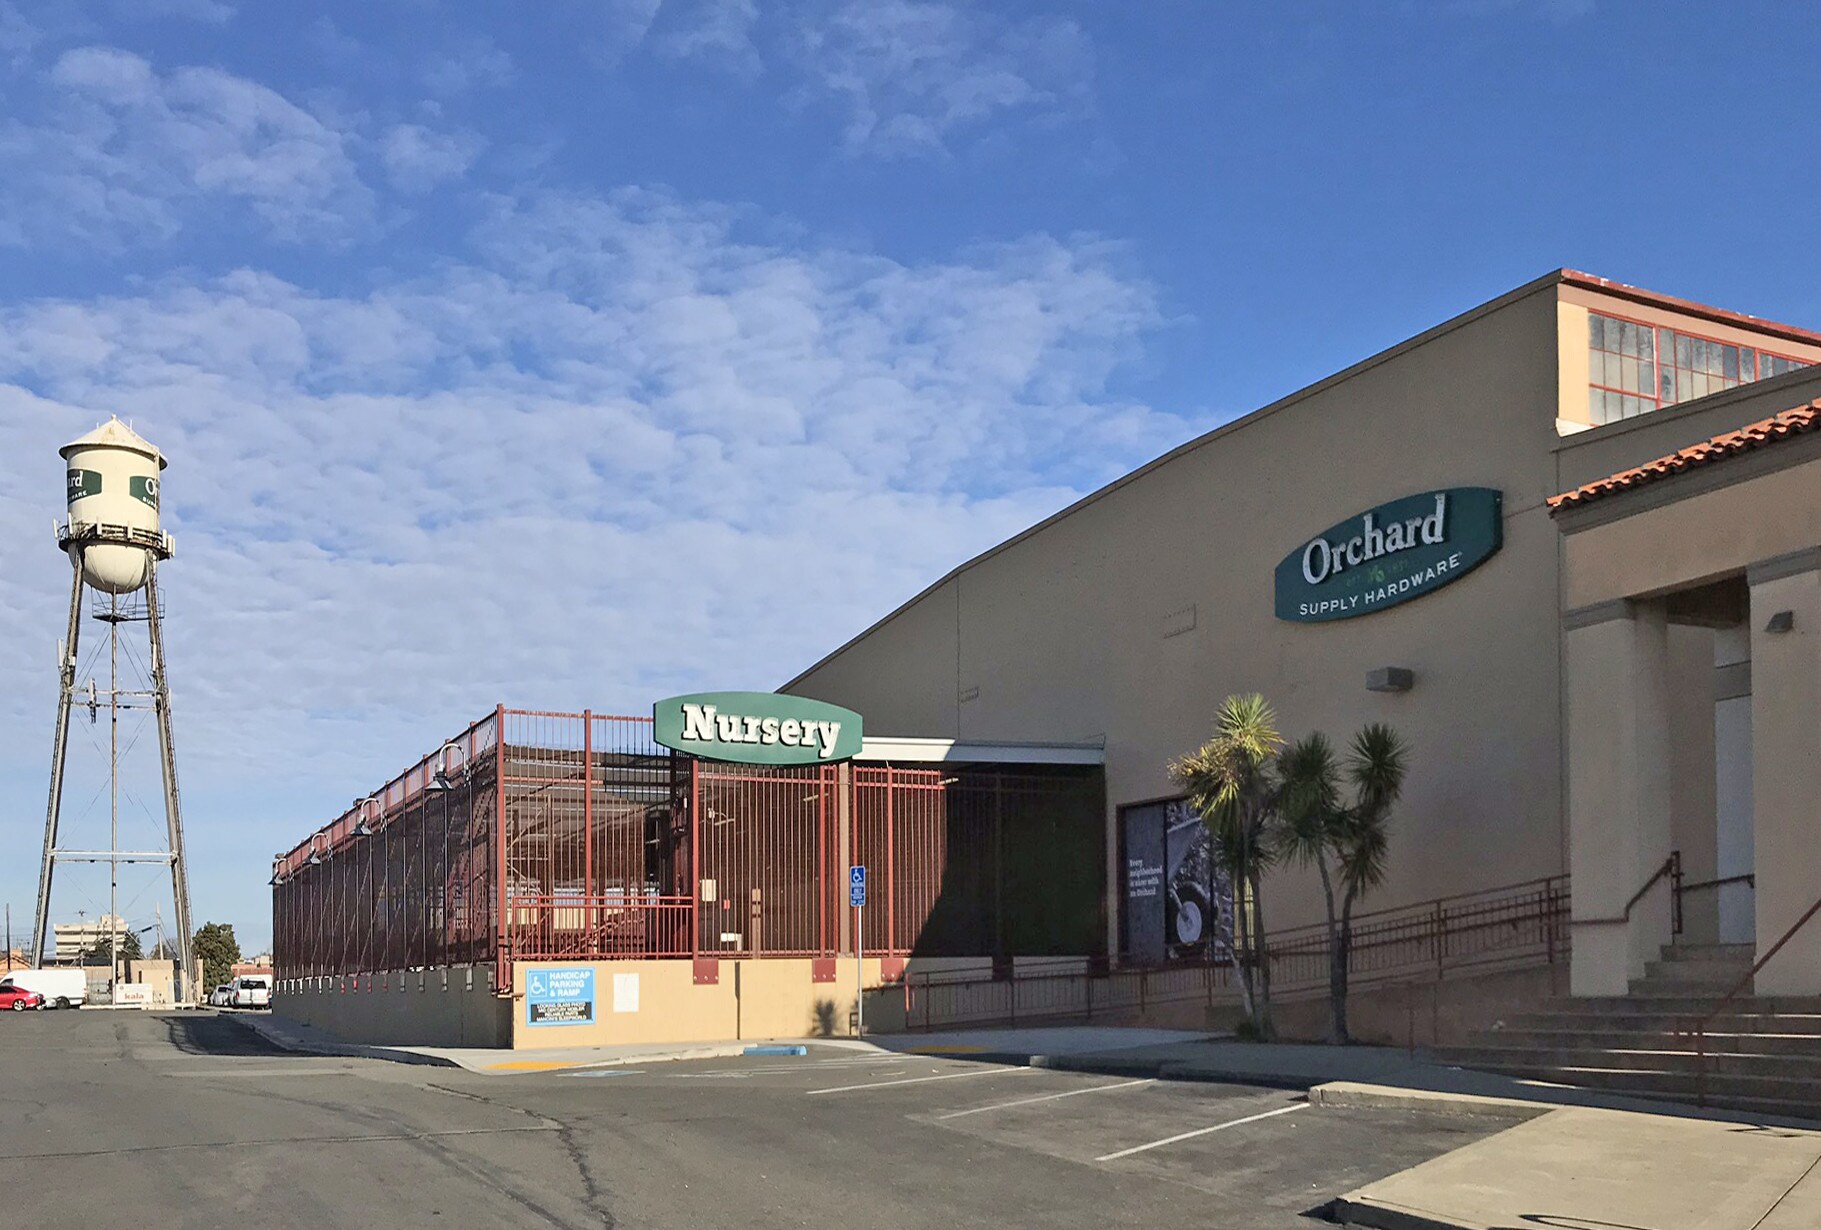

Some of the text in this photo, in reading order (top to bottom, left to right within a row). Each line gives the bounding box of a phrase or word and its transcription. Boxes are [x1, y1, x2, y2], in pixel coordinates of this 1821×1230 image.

[1302, 493, 1446, 585] Orchard
[1300, 553, 1461, 616] SUPPLY HARDWARE
[682, 703, 841, 758] Nursery
[549, 971, 591, 980] HANDICAP
[549, 980, 585, 989] PARKING
[557, 988, 581, 997] RAMP
